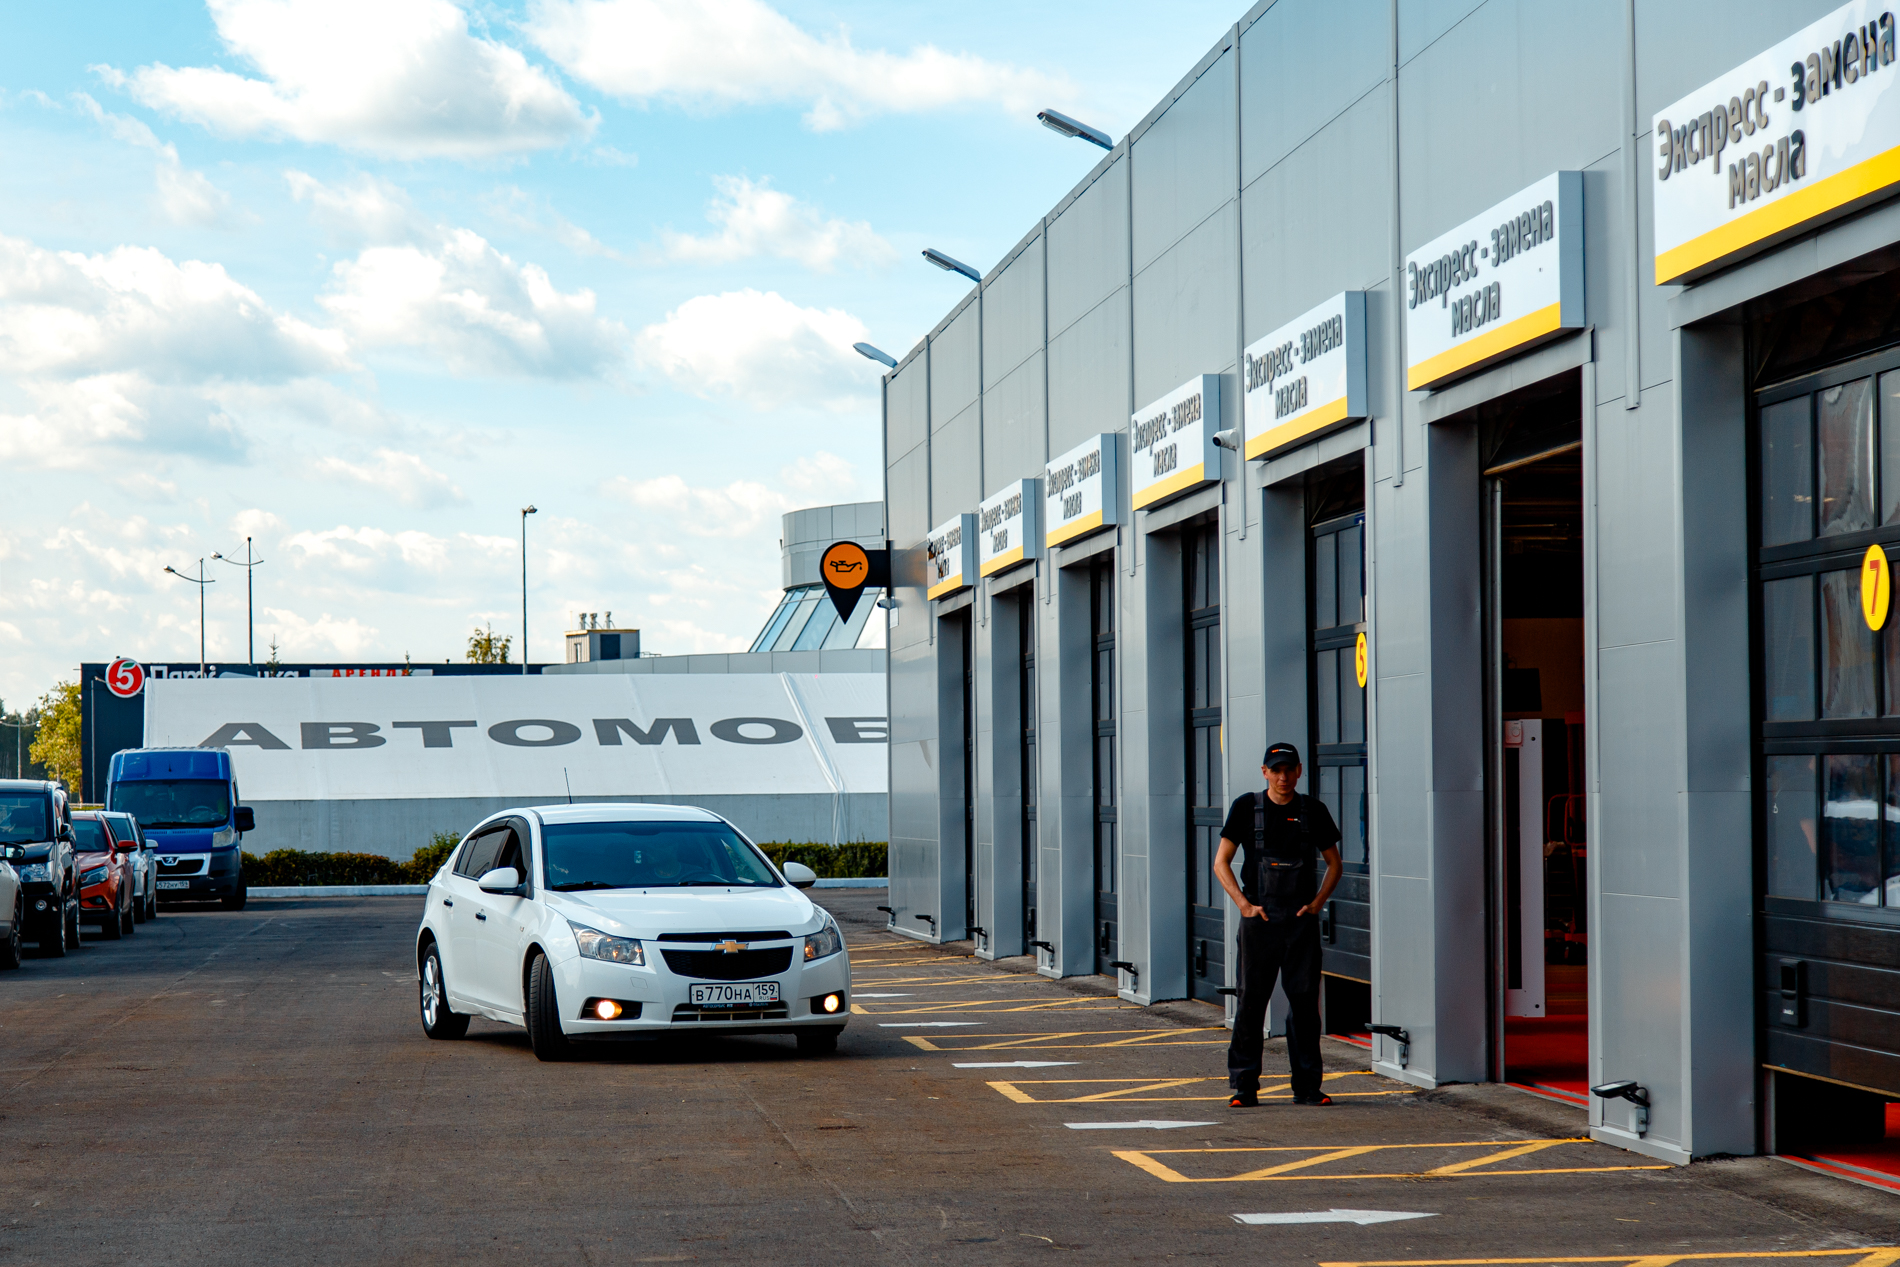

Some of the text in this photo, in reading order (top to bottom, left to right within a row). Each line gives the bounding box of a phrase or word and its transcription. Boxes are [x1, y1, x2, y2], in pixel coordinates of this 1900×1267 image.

[1658, 80, 1768, 181] Экспресс
[1791, 11, 1895, 112] замена
[1728, 129, 1806, 210] масла
[1408, 240, 1478, 310] Экспресс
[1491, 200, 1554, 268] замена
[1452, 281, 1501, 338] масла
[1246, 341, 1293, 395] Экспресс
[1300, 314, 1343, 364] замена
[1133, 412, 1167, 457] Экспресс
[1172, 393, 1201, 433] замена
[1275, 376, 1308, 419] масла
[1153, 443, 1177, 478] масла
[1870, 559, 1881, 615] 7
[116, 661, 136, 690] 5
[1359, 642, 1365, 678] 5
[199, 715, 888, 750] АВТОМОБ
[696, 984, 776, 1002] В770НА 159
